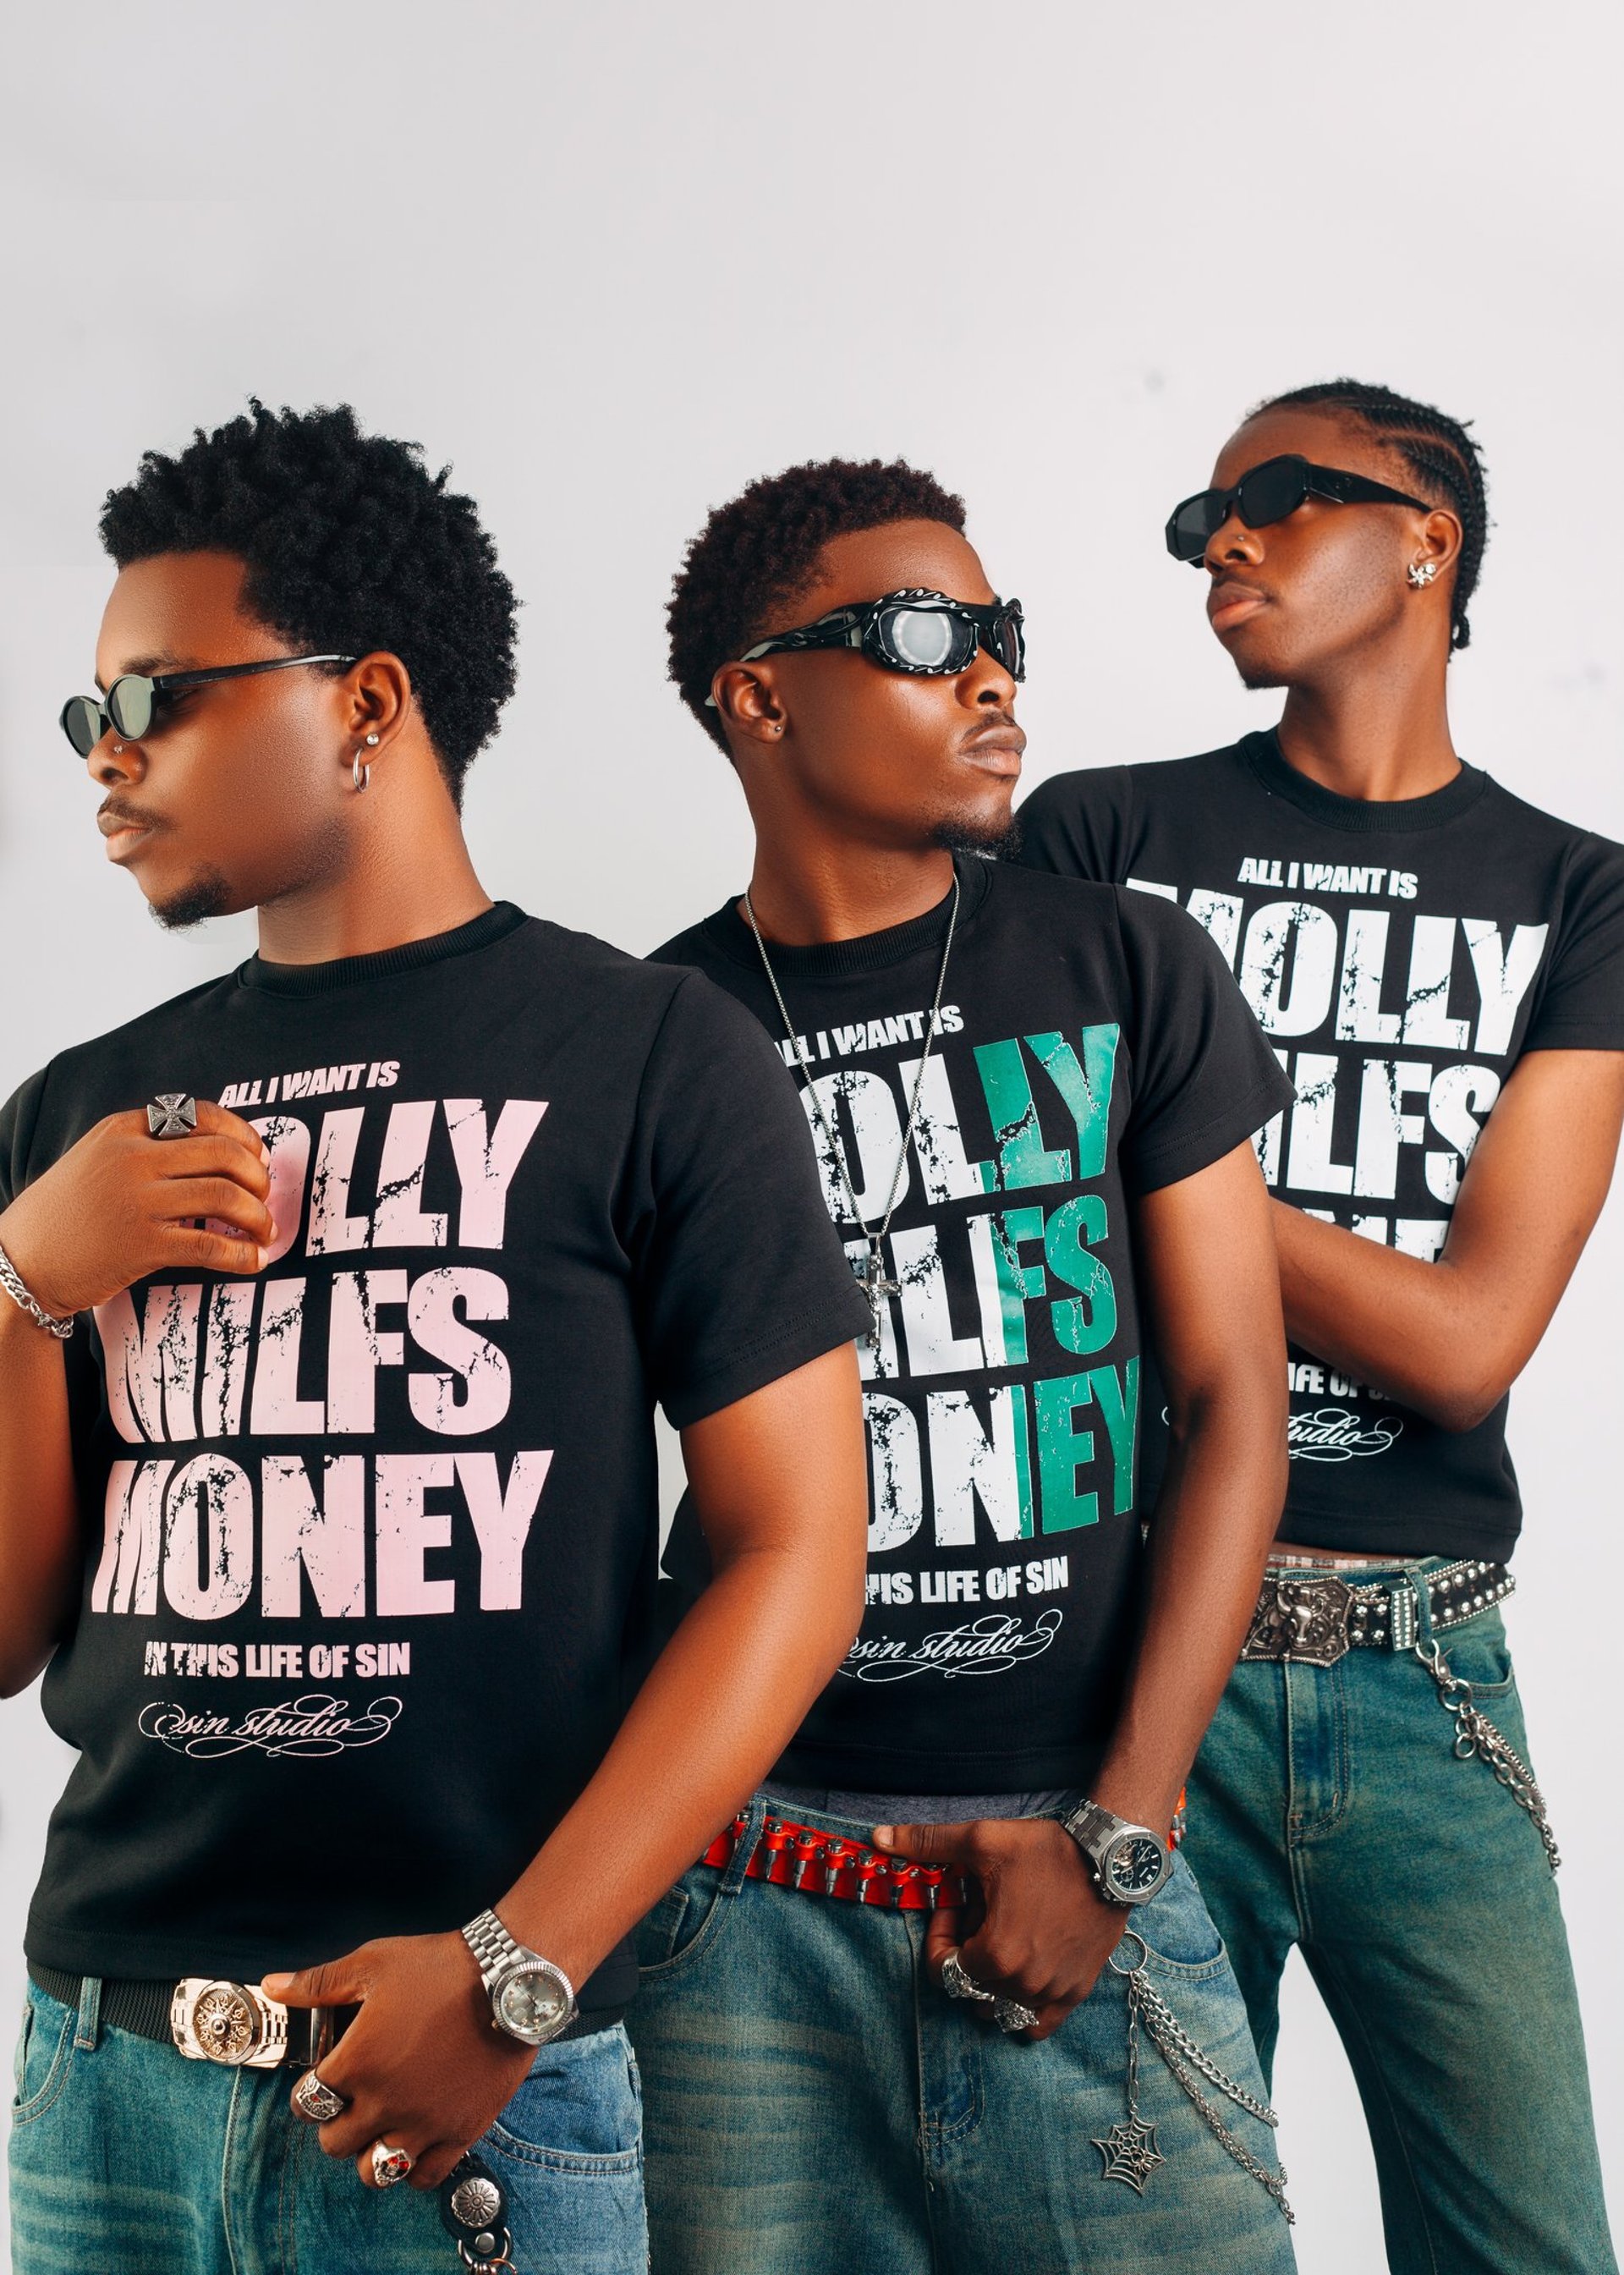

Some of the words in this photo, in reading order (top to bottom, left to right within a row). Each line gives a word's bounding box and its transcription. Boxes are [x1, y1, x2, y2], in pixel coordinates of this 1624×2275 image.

[1237, 857, 1284, 887] ALL
[1287, 862, 1300, 888] I
[1303, 863, 1387, 894] WANT
[1388, 870, 1418, 899] IS
[816, 1030, 831, 1060] I
[831, 1010, 924, 1056] WANT
[929, 1004, 964, 1036] IS
[218, 1079, 263, 1109] ALL
[266, 1076, 279, 1103] I
[282, 1063, 366, 1101] WANT
[365, 1060, 401, 1088] IS
[799, 1023, 1121, 1224] OLLY
[179, 1098, 550, 1265] OLLY
[92, 1266, 511, 1443] MILFS
[1287, 1362, 1325, 1394] IFE
[861, 1355, 1139, 1552] ONEY
[91, 1449, 554, 1620] MONEY
[864, 1572, 914, 1605] HIS
[919, 1570, 981, 1603] LIFE
[985, 1566, 1022, 1601] OF
[1025, 1555, 1069, 1595] SIN
[144, 1641, 167, 1677] IN
[170, 1642, 239, 1678] THIS
[245, 1644, 303, 1679] LIFE
[309, 1644, 350, 1679] OF
[354, 1642, 411, 1678] SIN
[909, 1609, 1062, 1668] studio
[232, 1694, 403, 1749] studio
